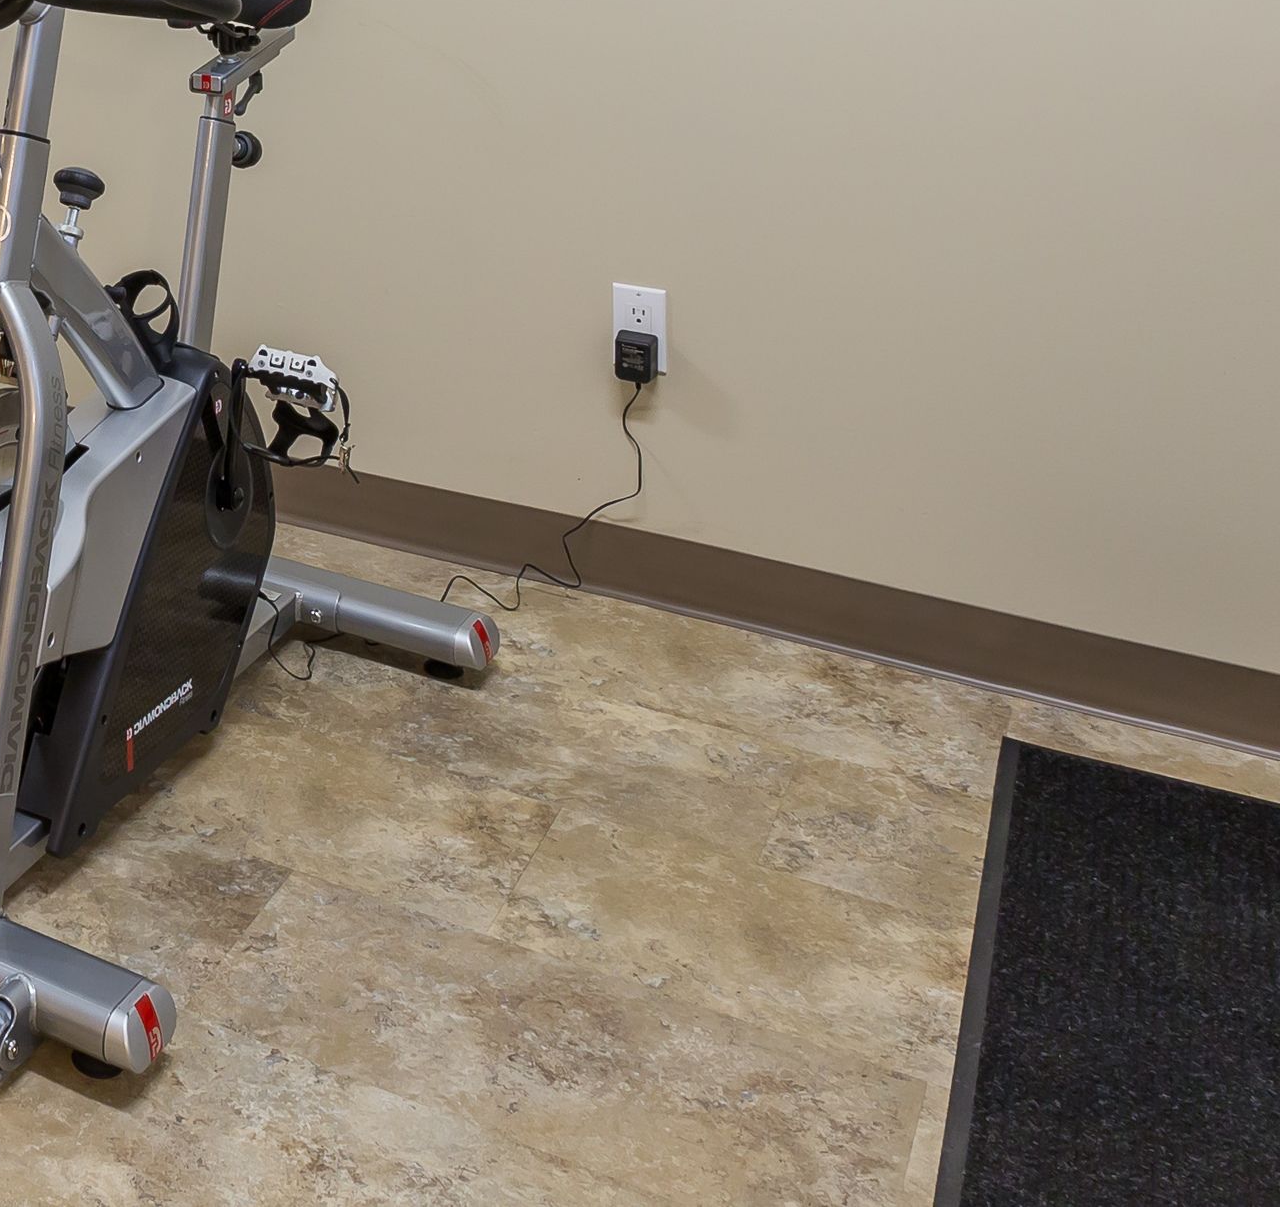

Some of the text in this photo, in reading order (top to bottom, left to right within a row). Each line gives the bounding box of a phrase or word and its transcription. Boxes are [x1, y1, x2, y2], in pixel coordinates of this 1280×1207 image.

[0, 375, 65, 793] DIAMONDBACK Fitness
[133, 678, 193, 735] DIAMONDBACK
